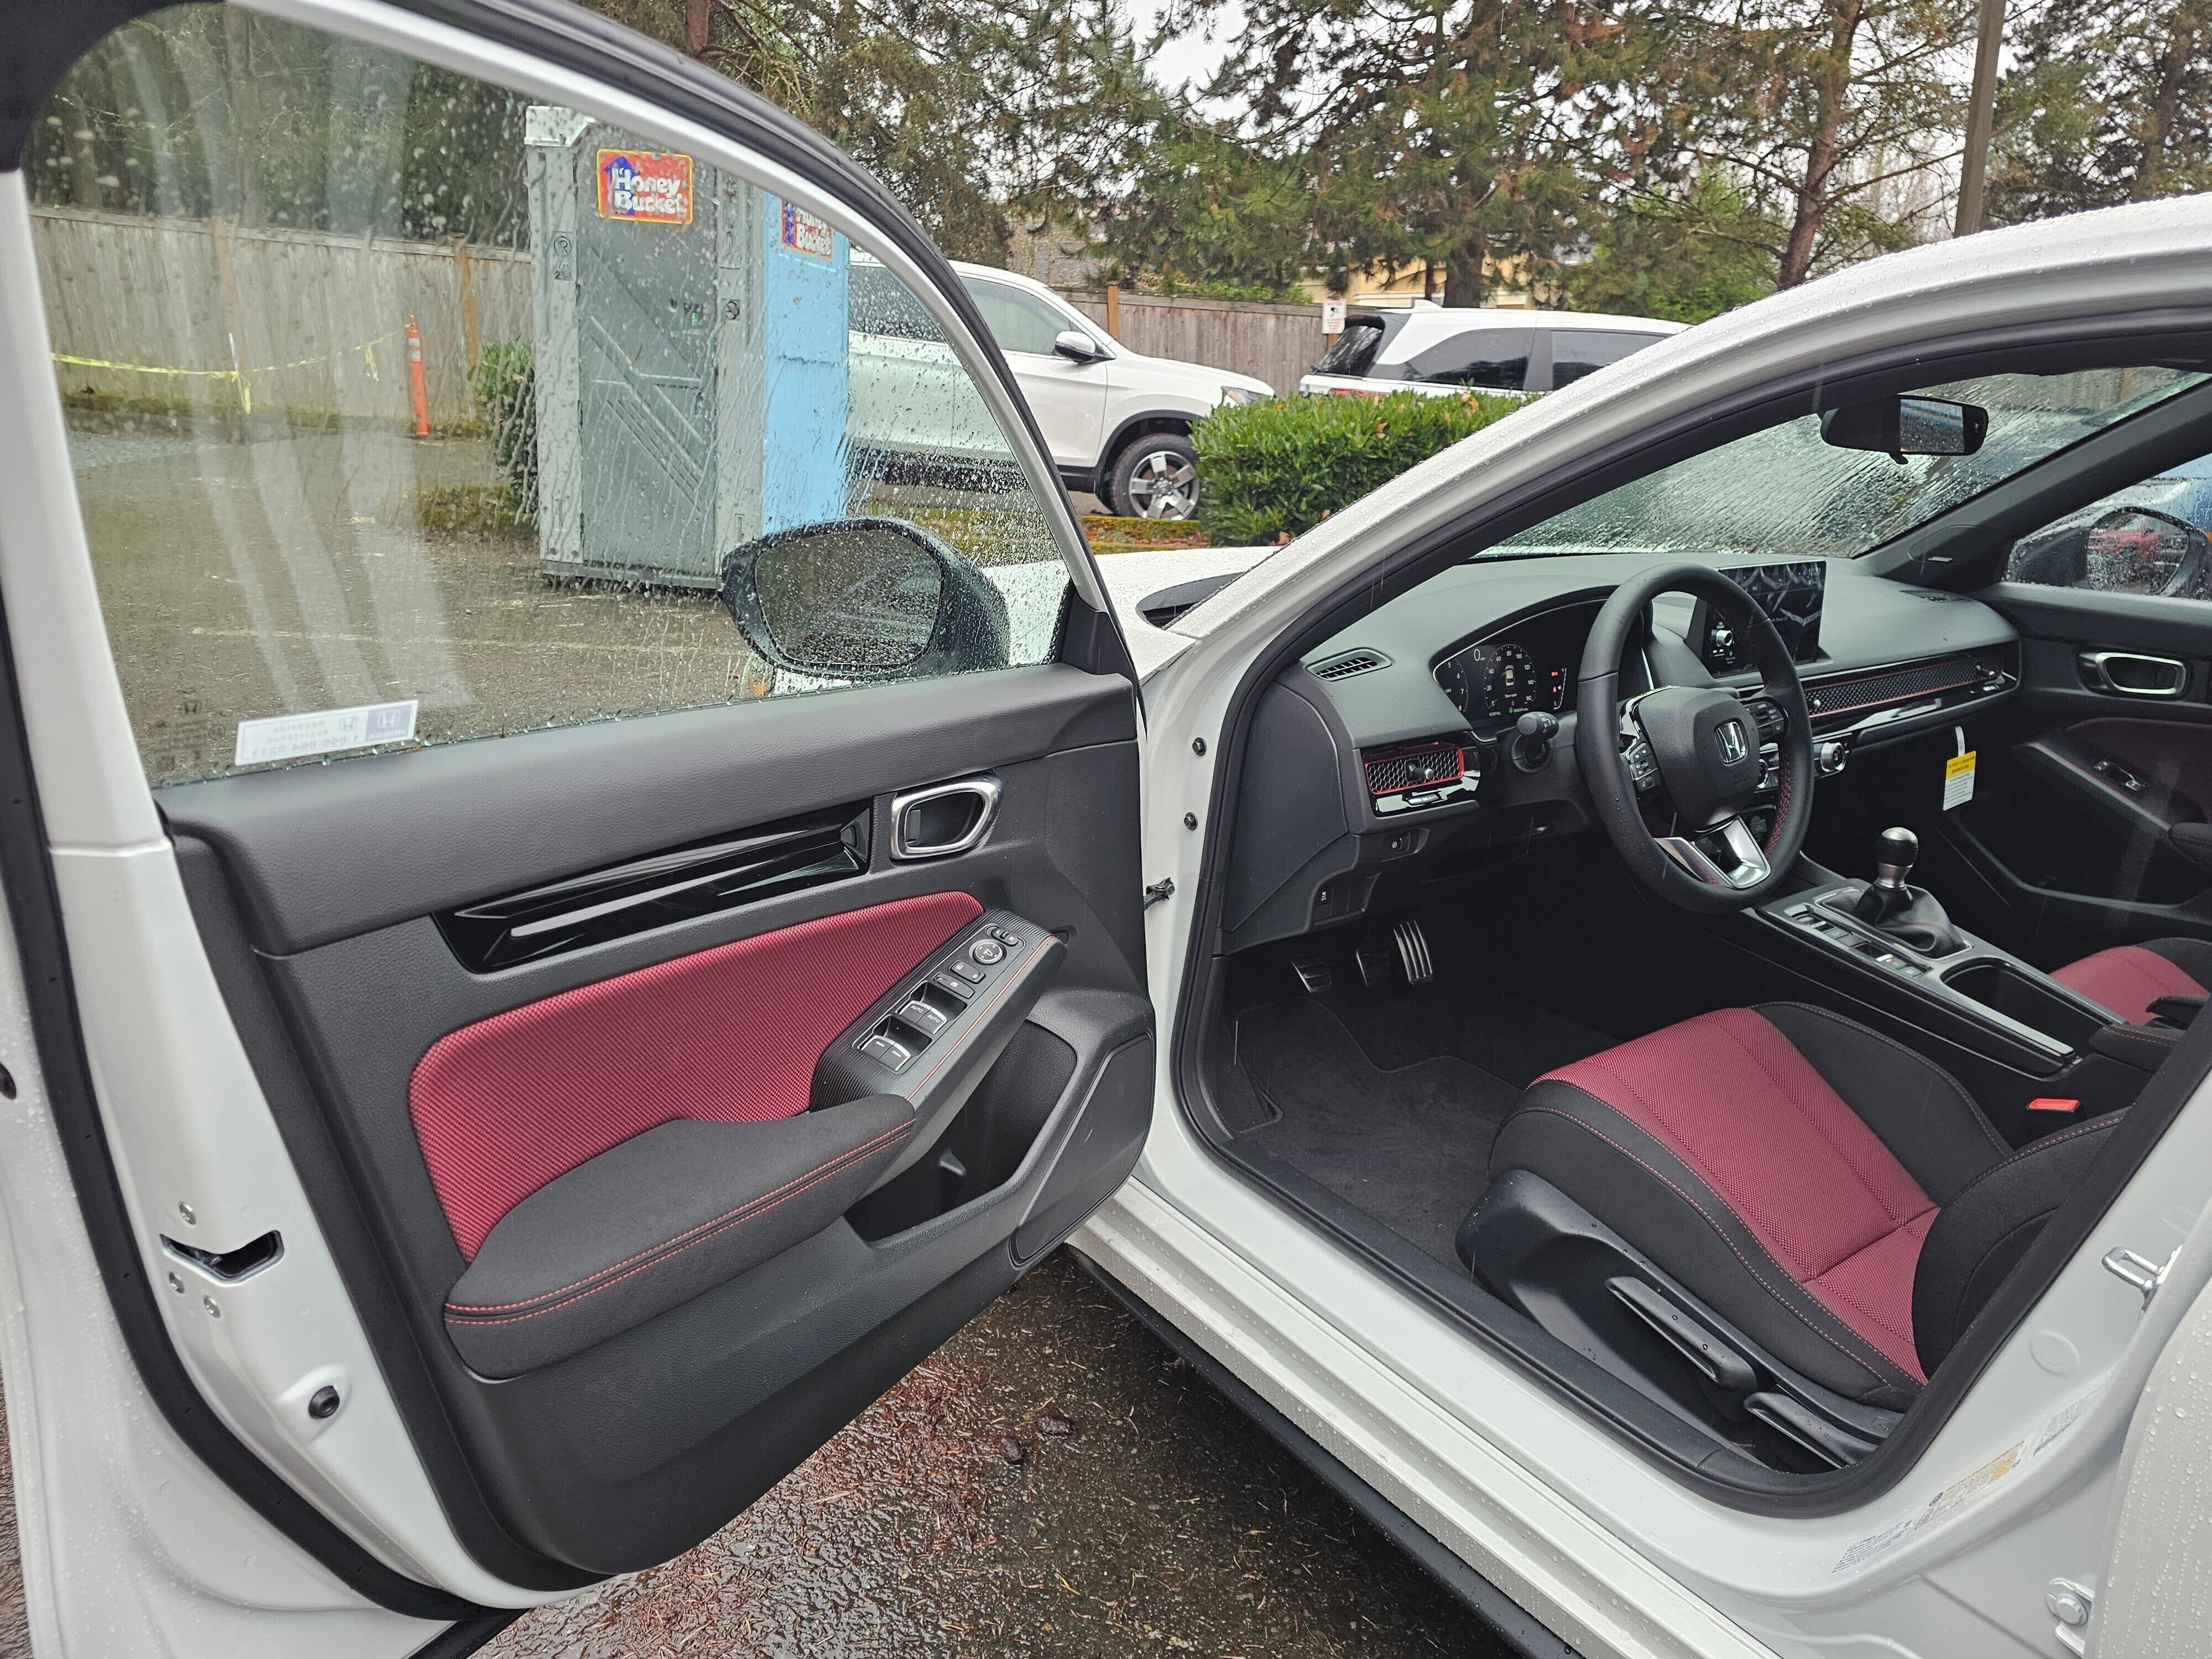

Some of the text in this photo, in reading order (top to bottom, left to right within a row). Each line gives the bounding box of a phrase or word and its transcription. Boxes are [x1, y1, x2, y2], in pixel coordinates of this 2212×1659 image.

[612, 167, 681, 197] Honey
[614, 190, 687, 215] Bucket
[1474, 649, 1480, 661] 0
[910, 1005, 924, 1014] AUTO
[928, 1014, 941, 1023] AUTO
